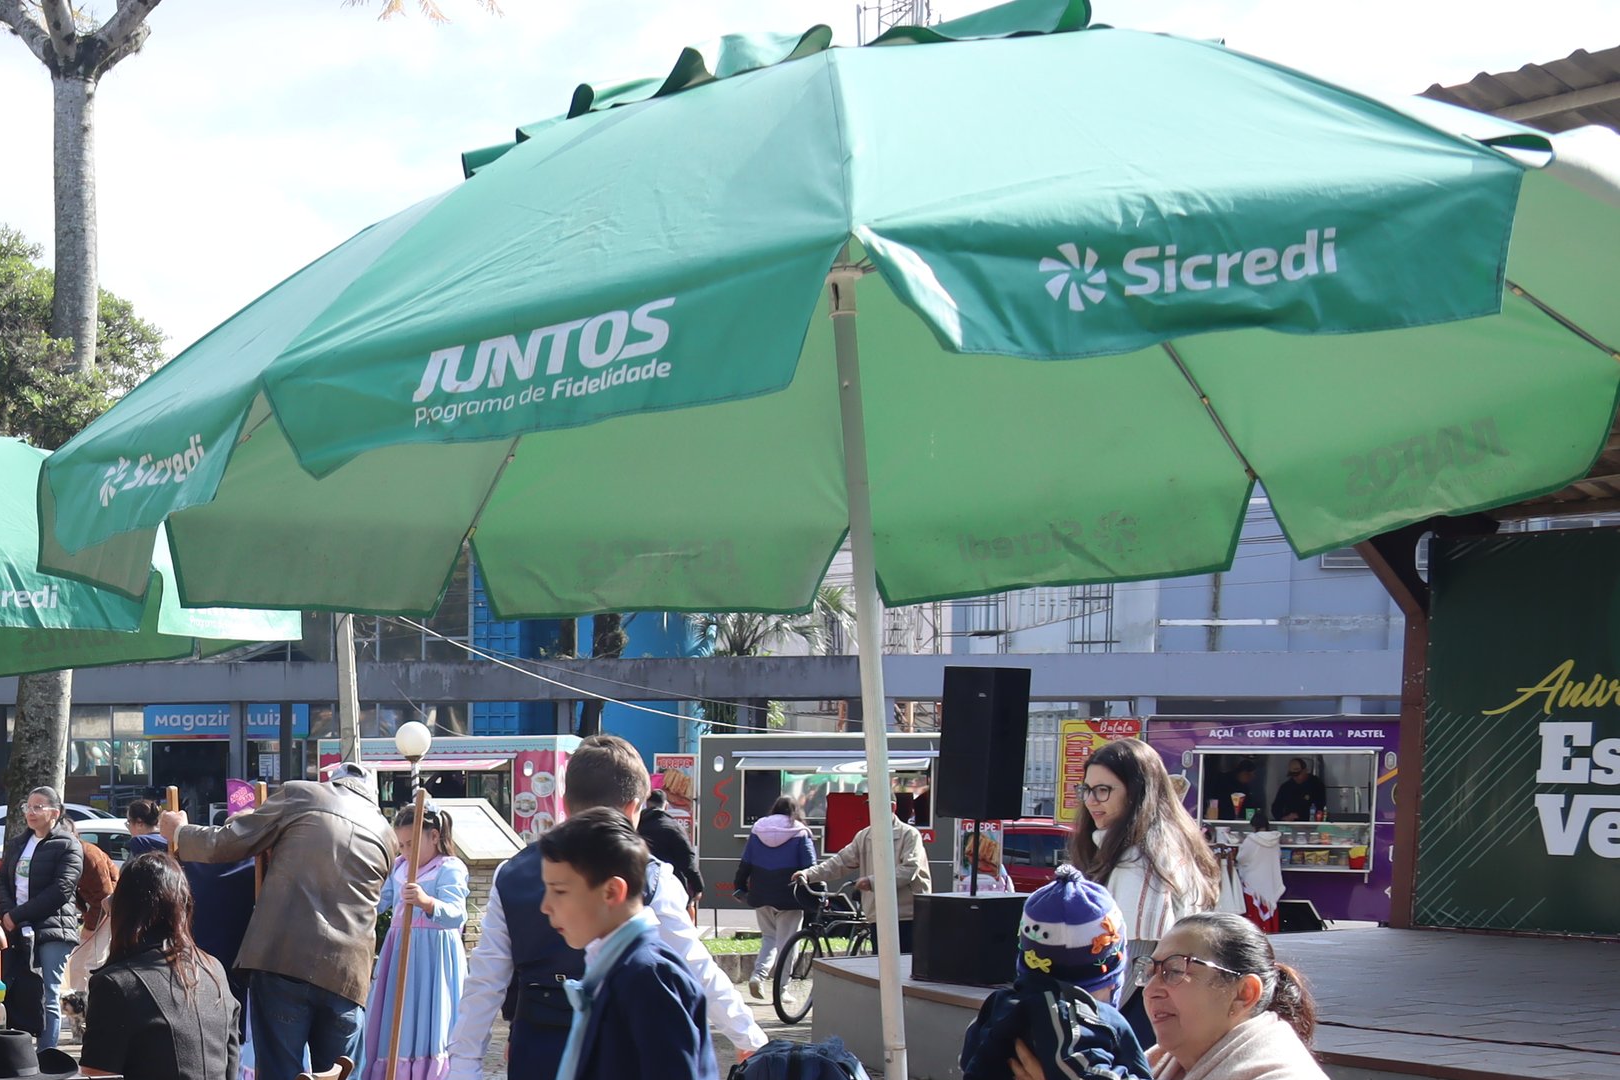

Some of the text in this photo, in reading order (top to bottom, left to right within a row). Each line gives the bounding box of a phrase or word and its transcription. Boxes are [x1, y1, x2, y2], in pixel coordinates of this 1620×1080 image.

[1122, 227, 1337, 297] Sicredi
[412, 297, 676, 402] JUNTOS
[414, 358, 672, 428] Programa de Fidelidade
[121, 432, 205, 491] Sicredi
[1100, 722, 1133, 733] Batata
[1209, 728, 1385, 740] AÇAÍ CONE DE BATATA PASTEL
